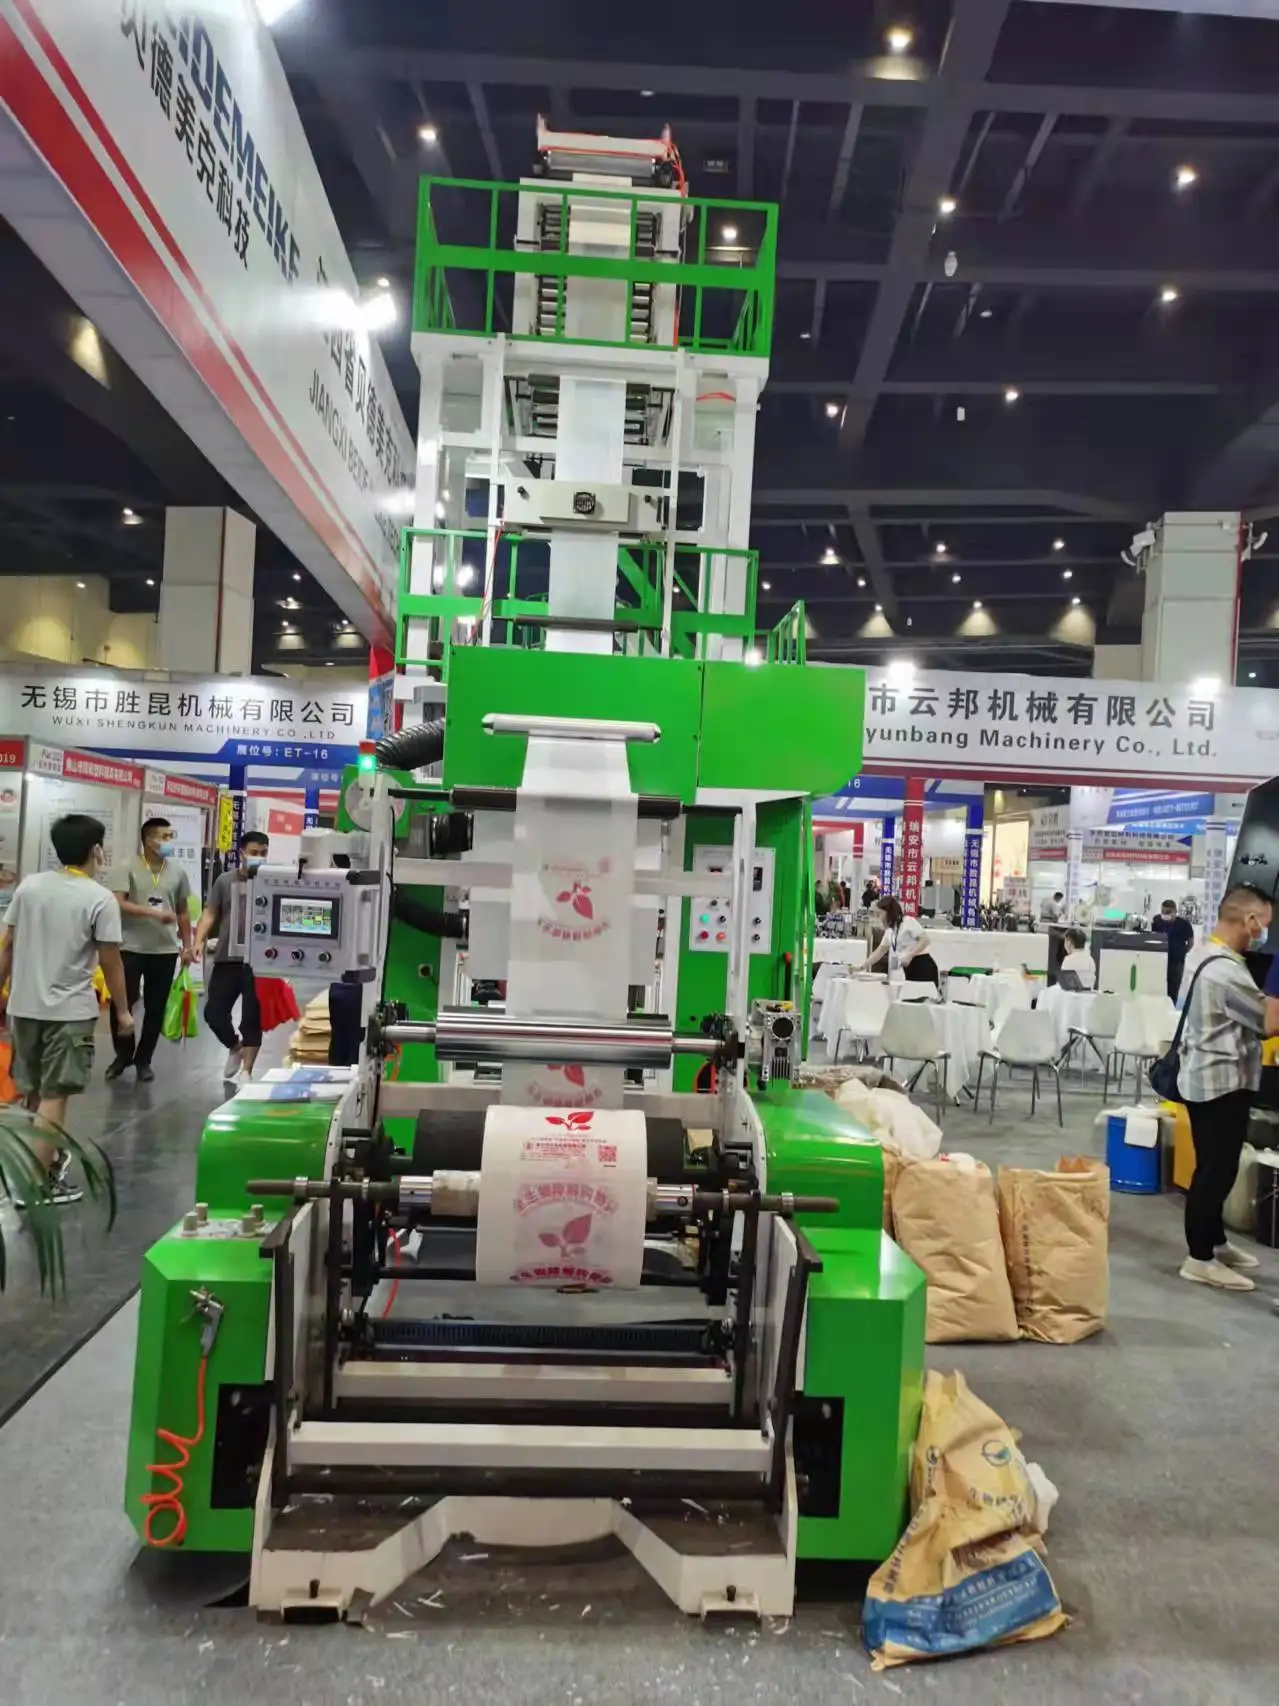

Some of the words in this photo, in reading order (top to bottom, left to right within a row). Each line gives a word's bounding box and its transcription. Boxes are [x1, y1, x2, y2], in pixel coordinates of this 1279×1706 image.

[21, 684, 354, 726] 无锡市胜昆机械有限公司
[52, 715, 91, 727] WUXI
[97, 718, 178, 731] SHENGKUN
[183, 723, 270, 737] MACHINERY
[868, 683, 1215, 731] 市云邦机械有限公司
[865, 725, 969, 749] yunbang
[979, 729, 1105, 756] Machinery
[1115, 735, 1161, 757] Co.,
[1172, 737, 1217, 758] Ltd.
[904, 820, 921, 914] 瑞安市云邦机械
